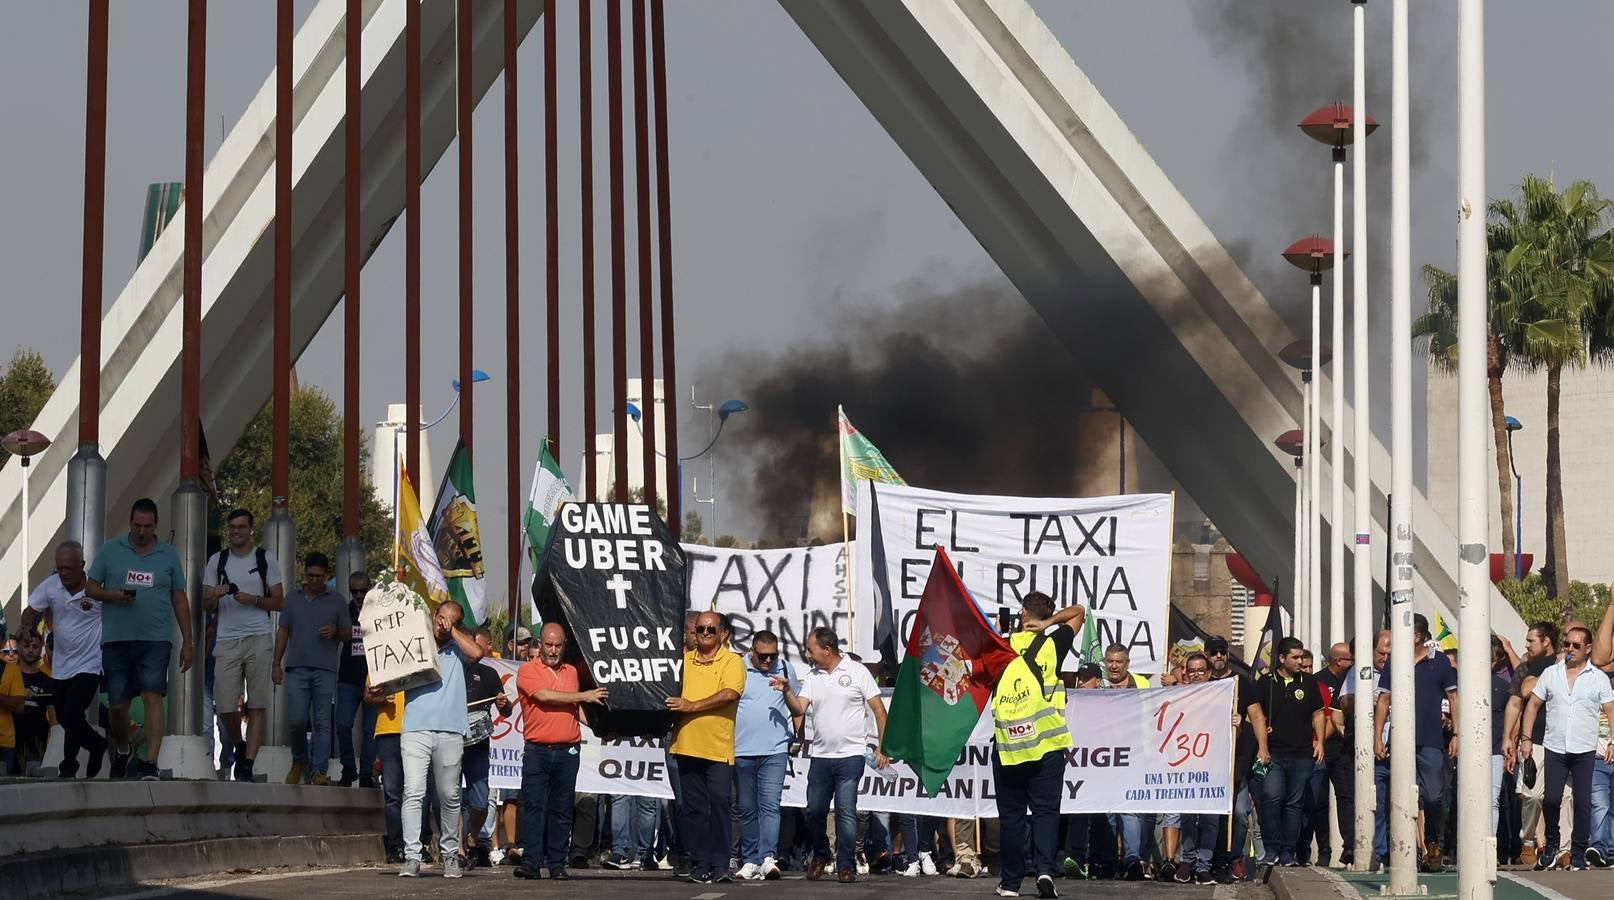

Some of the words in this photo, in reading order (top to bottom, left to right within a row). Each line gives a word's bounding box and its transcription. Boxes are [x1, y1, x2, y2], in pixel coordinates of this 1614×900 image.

[561, 503, 652, 535] GAME
[916, 508, 979, 552] EL
[1010, 513, 1117, 556] TAXI
[565, 538, 666, 571] UBER
[128, 572, 151, 581] NO+
[997, 563, 1137, 610] RUINA
[589, 627, 676, 652] FUCK
[368, 636, 428, 672] TAXI
[593, 658, 682, 684] CABIFY
[1008, 724, 1032, 735] NO+
[1154, 701, 1210, 767] 1/30
[1063, 747, 1131, 767] XIGE
[599, 759, 665, 781] QUE
[1145, 773, 1163, 785] UNA
[1167, 772, 1185, 784] VTC
[1188, 771, 1209, 783] POR
[857, 776, 974, 799] UMPLAN
[1125, 789, 1150, 800] CADA
[1155, 788, 1196, 799] TREINTA
[1199, 786, 1225, 798] TAXIS
